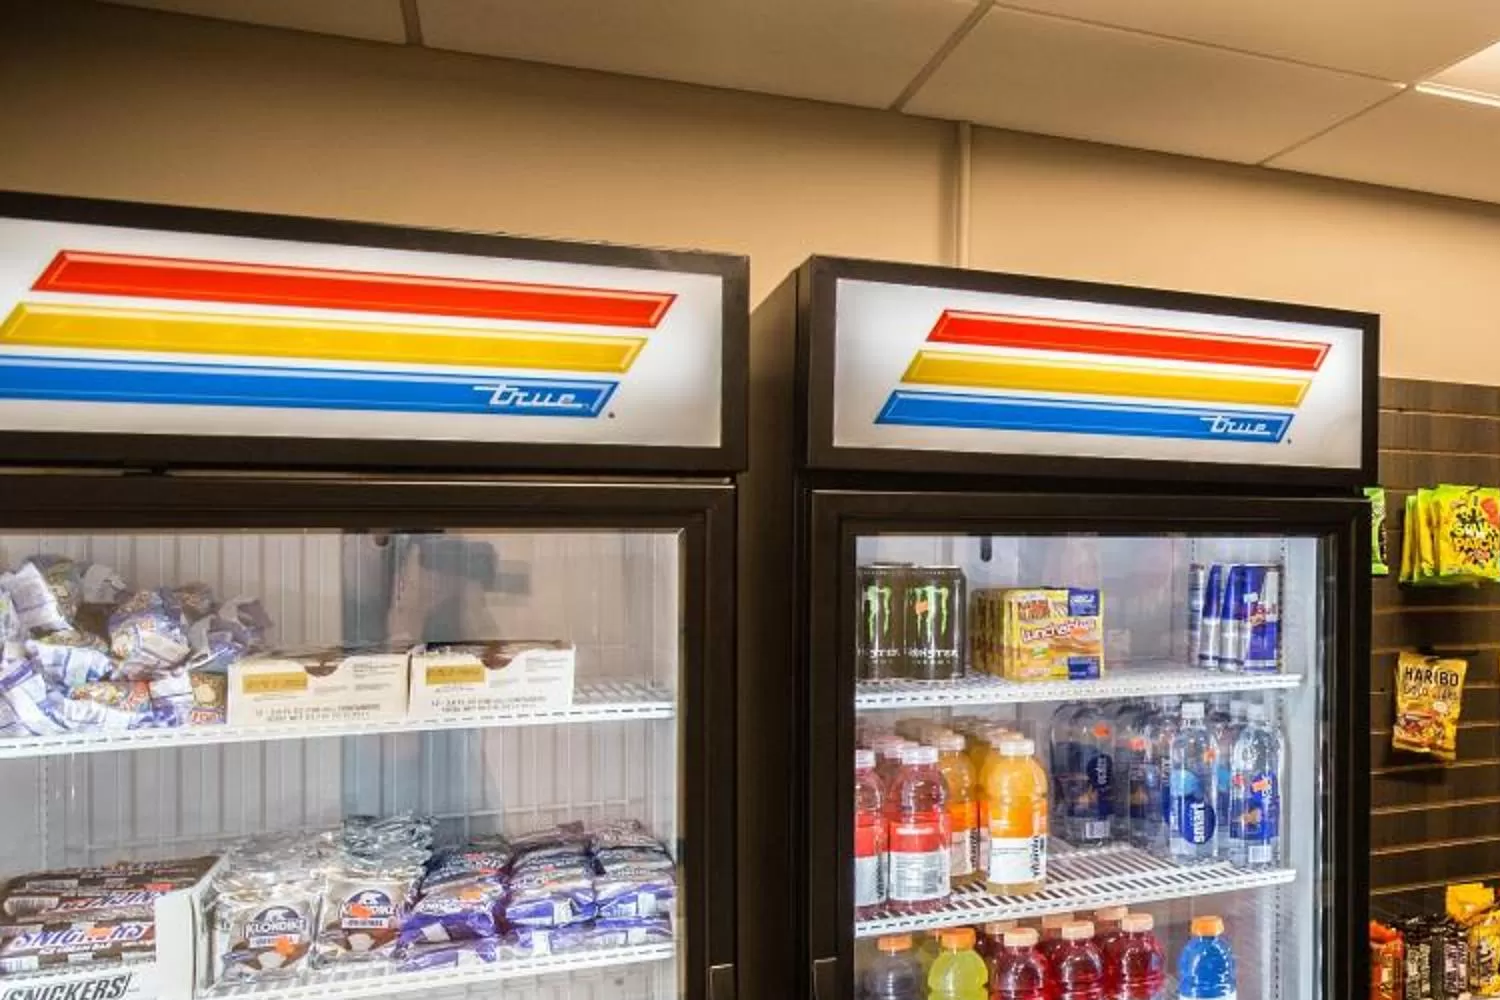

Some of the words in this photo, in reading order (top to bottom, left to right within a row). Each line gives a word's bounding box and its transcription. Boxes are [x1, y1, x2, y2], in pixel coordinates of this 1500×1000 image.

[1405, 667, 1459, 687] HARIBO
[1191, 802, 1205, 843] smart
[16, 922, 148, 951] SNICRS
[245, 917, 306, 938] KLONDIKE
